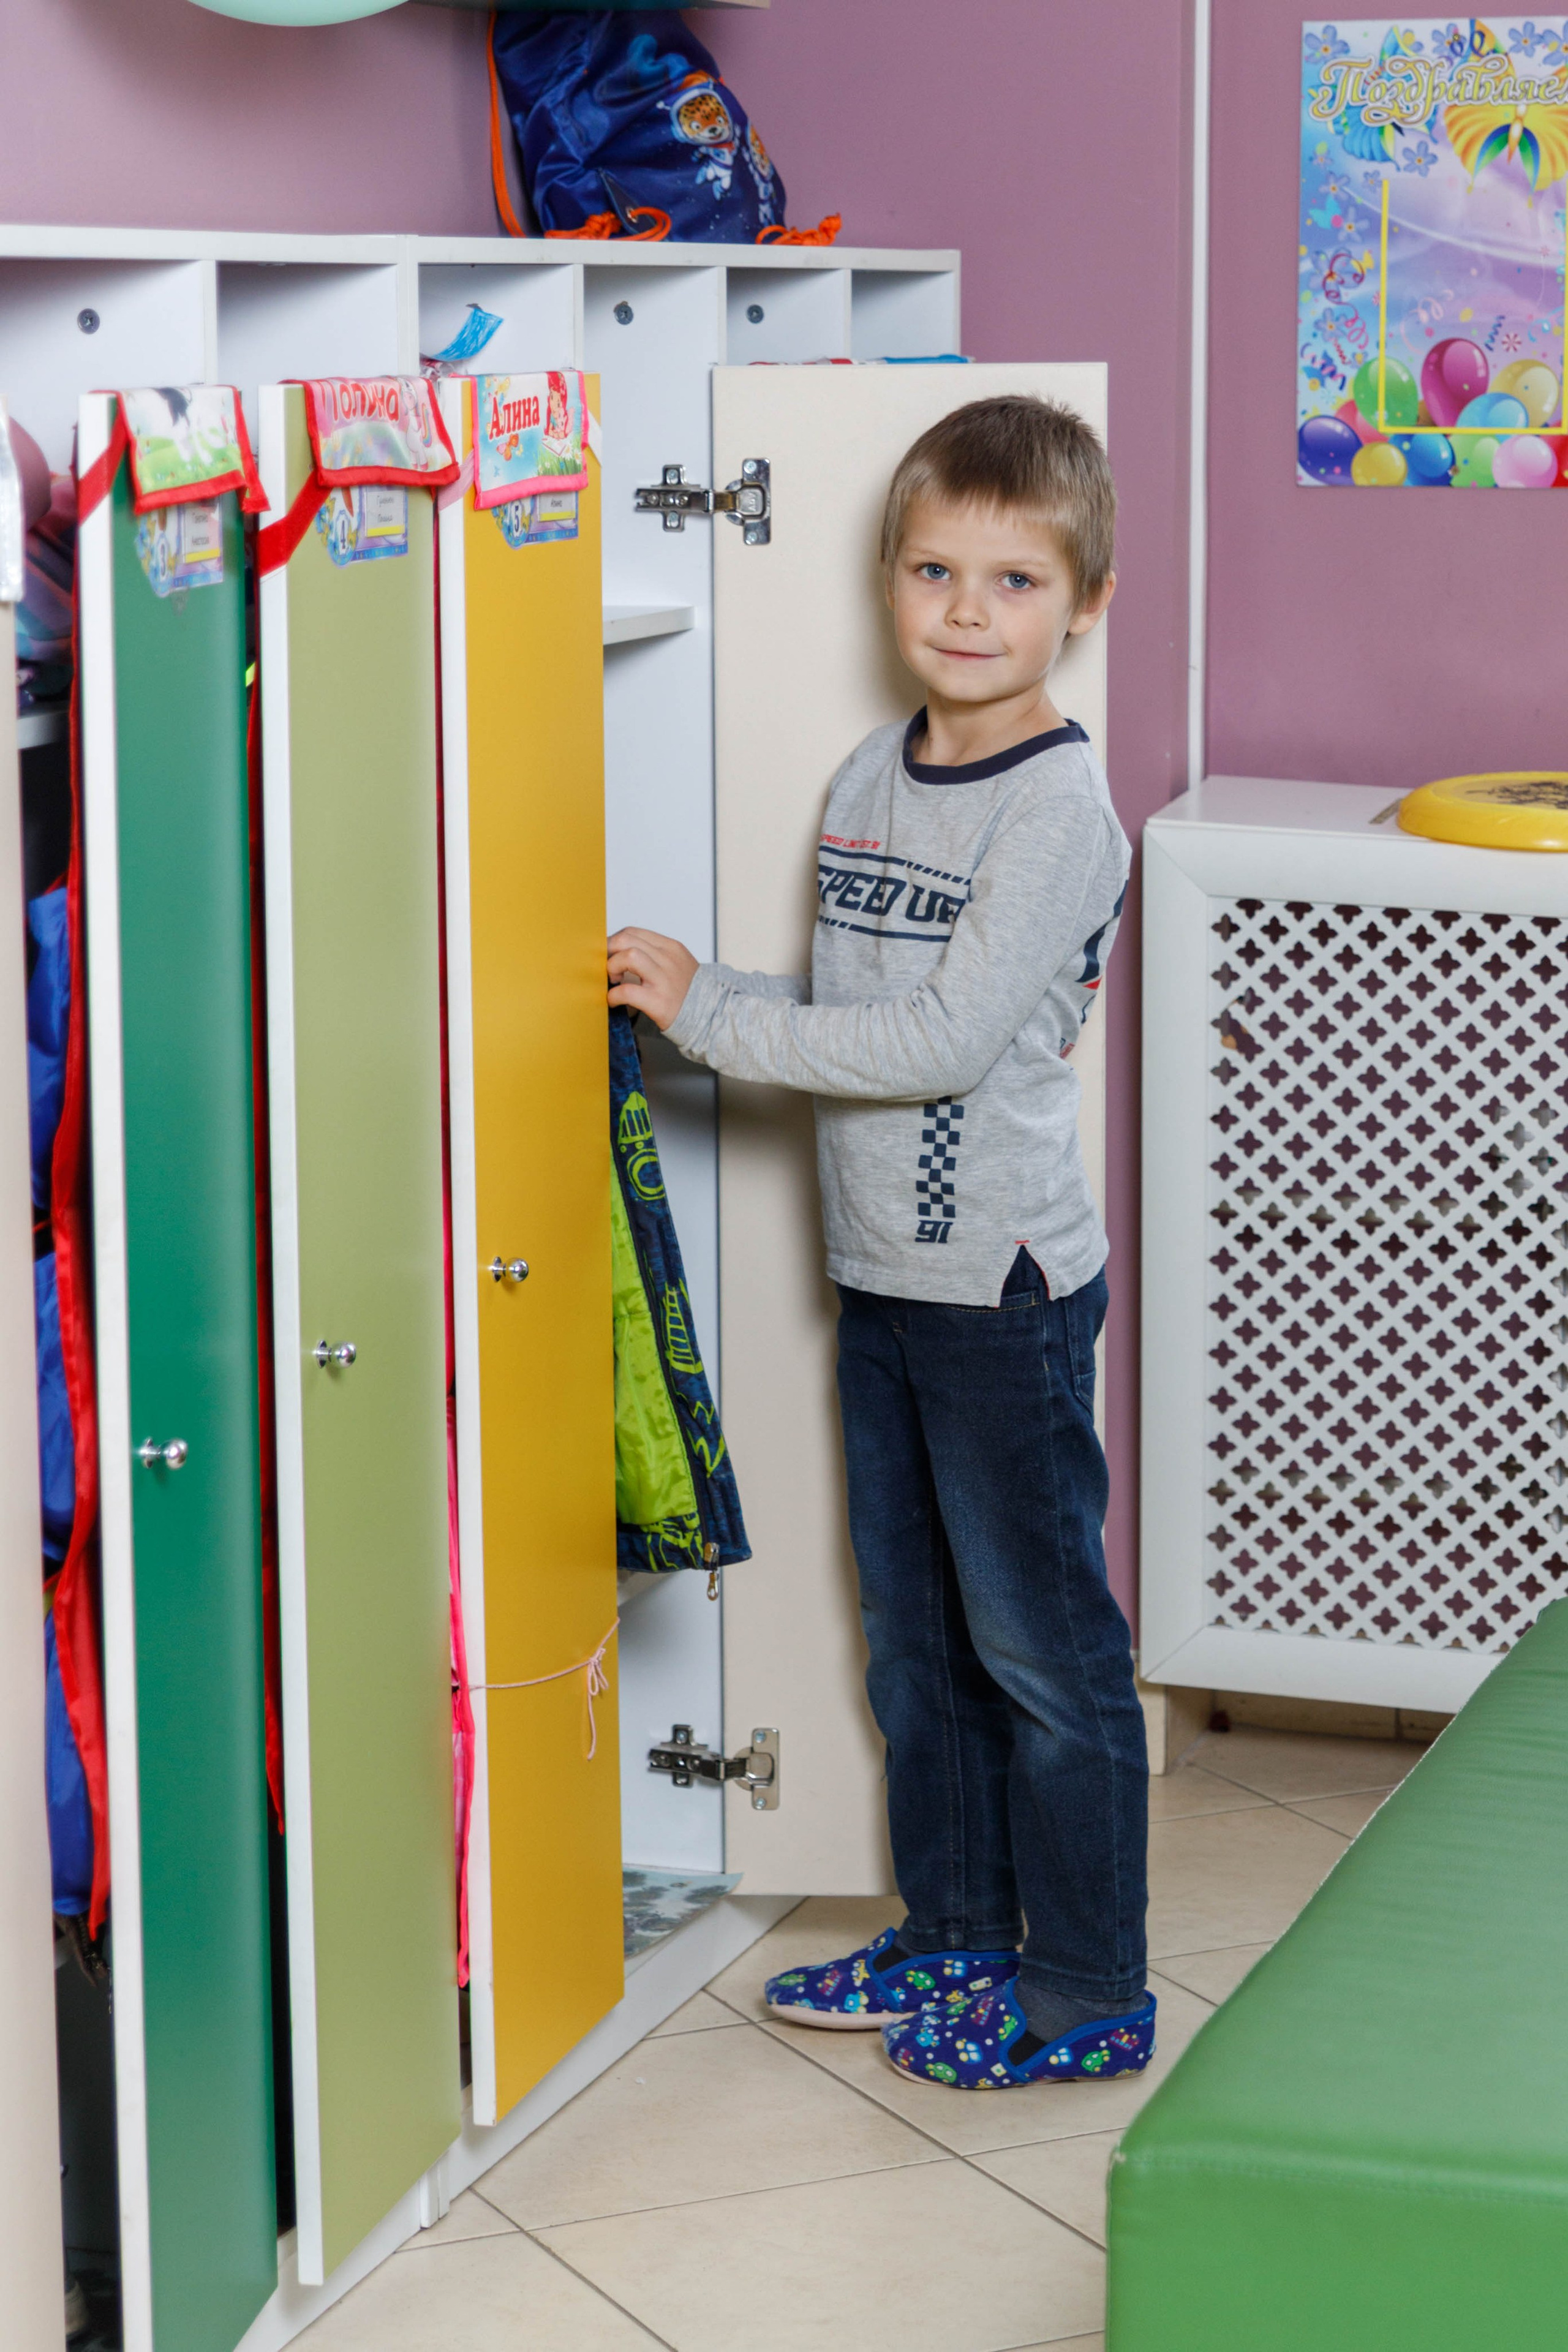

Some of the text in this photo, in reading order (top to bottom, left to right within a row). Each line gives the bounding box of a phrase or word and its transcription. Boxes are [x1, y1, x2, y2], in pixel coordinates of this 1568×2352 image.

[1310, 56, 1568, 124] Поздравляе
[489, 396, 540, 440] Алина
[340, 519, 346, 549] 4
[514, 505, 519, 532] 5
[160, 543, 166, 576] 3
[818, 864, 966, 924] SPEED UP
[915, 1219, 954, 1244] 91
